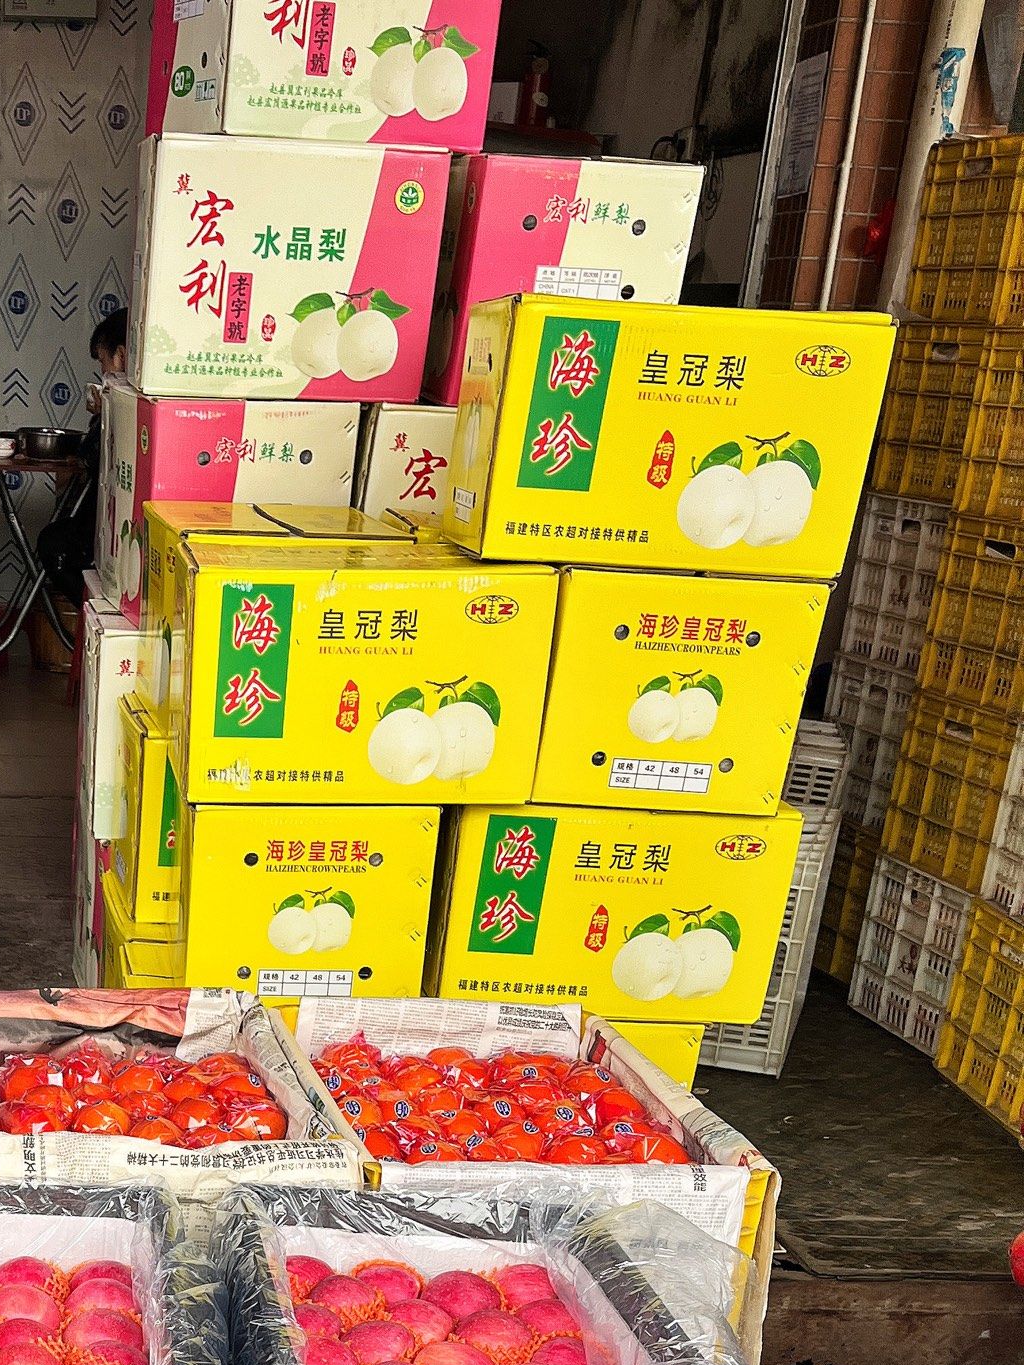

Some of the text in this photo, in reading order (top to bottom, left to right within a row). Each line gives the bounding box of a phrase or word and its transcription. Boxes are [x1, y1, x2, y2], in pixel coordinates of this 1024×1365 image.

[173, 173, 193, 194] 冀
[179, 190, 234, 318] 宏利
[253, 225, 347, 262] 水晶梨
[638, 349, 746, 391] 皇冠梨
[530, 330, 602, 476] 海珍
[637, 390, 738, 407] HUANG GUAN LI
[389, 432, 411, 453] 冀
[650, 439, 675, 485] 特级
[505, 521, 649, 544] 福建特区农超对接特供精品
[318, 608, 418, 642] 皇冠梨
[636, 613, 747, 644] 海珍皇冠梨
[318, 646, 414, 656] HUANG GUAN LI
[634, 640, 742, 656] HAIZHENCROWNPEARS
[224, 594, 280, 726] 海珍
[339, 688, 360, 730] 特级
[614, 775, 630, 784] SIZE
[617, 761, 704, 776] 规格 42 48 54
[266, 840, 369, 863] 海珍皇冠梨
[574, 841, 672, 872] 皇冠梨
[265, 864, 367, 874] HAIZHENCROWNPEARS
[574, 874, 664, 887] HUANG GUAN LI
[479, 826, 540, 942] 海珍
[587, 913, 609, 949] 特级
[262, 973, 346, 982] 规格 42 48 54
[458, 979, 588, 997] 福建特区农超对接特供精品
